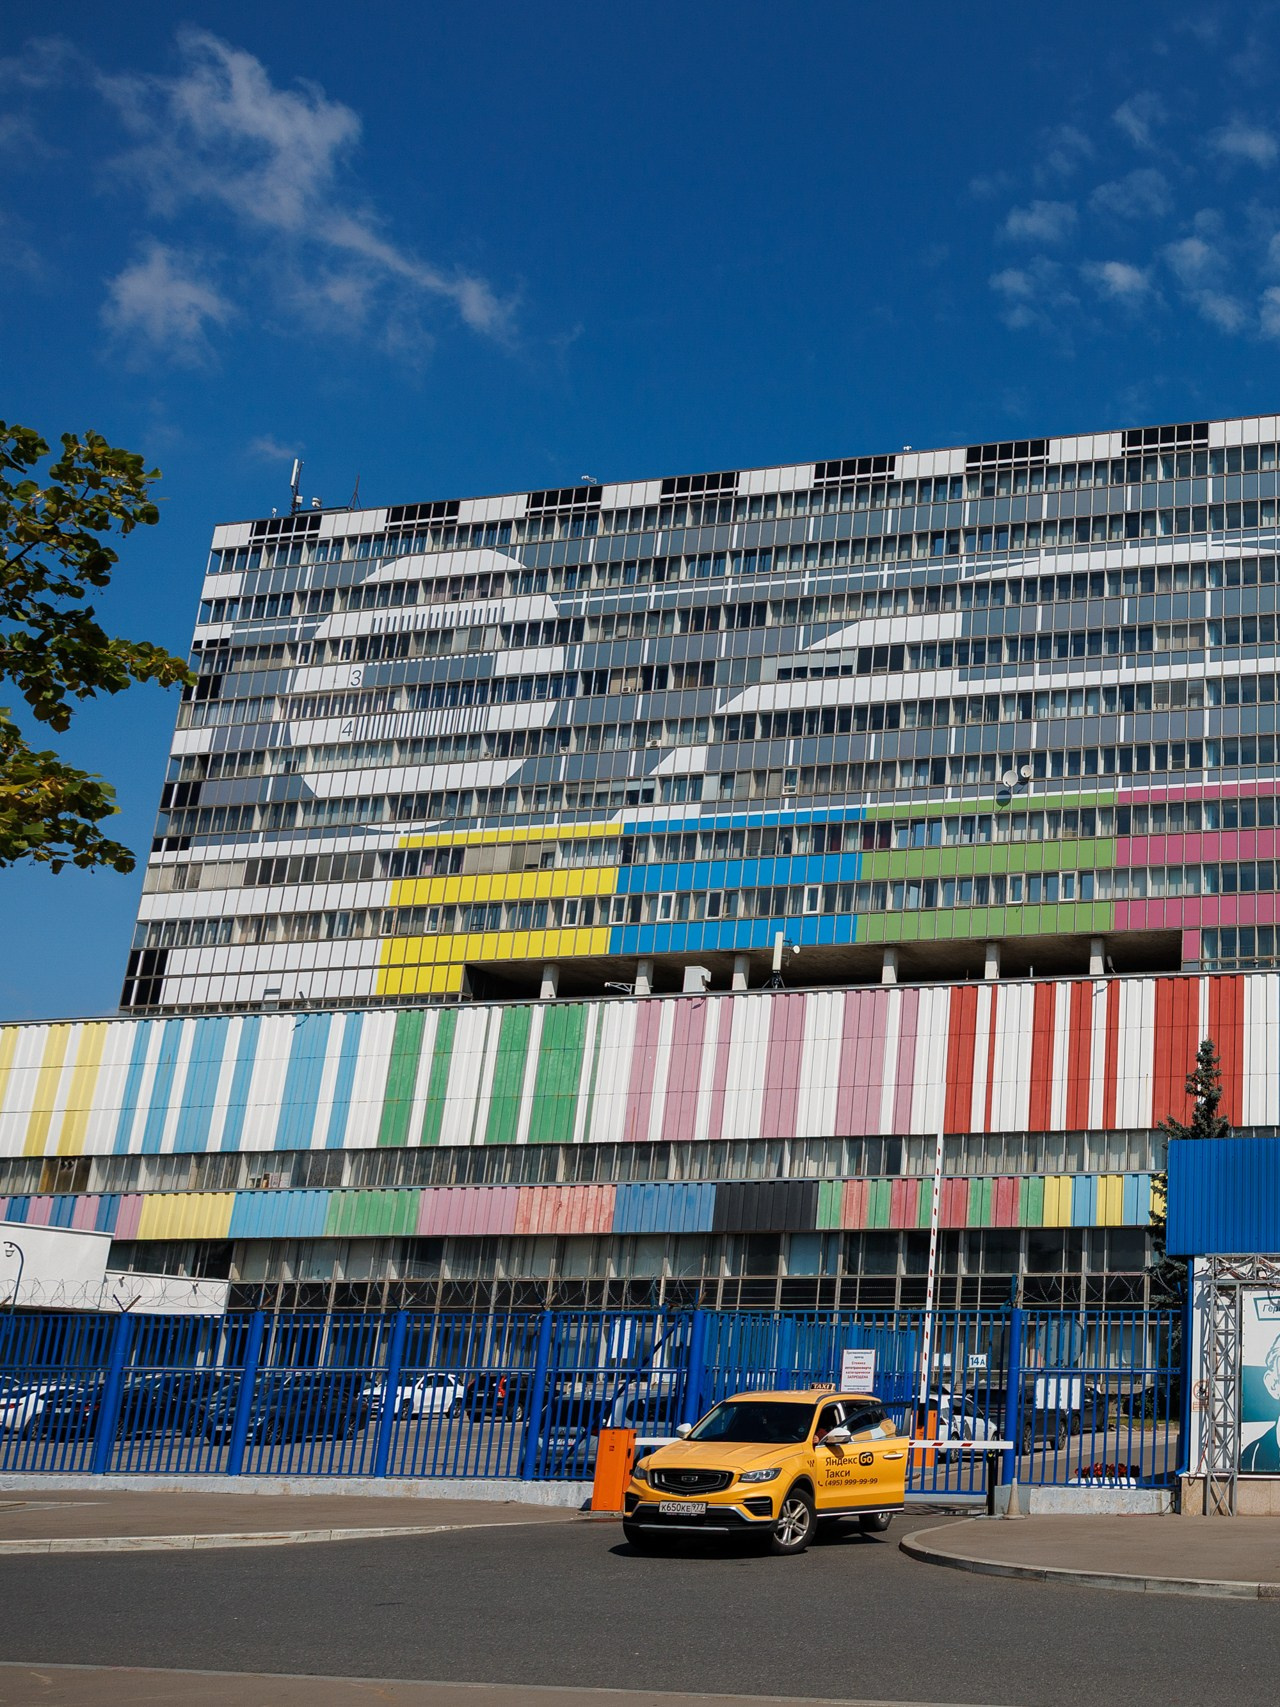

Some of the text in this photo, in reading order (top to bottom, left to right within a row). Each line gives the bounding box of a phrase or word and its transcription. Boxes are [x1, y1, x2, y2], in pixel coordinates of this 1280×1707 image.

[350, 669, 362, 687] 3
[342, 720, 353, 737] 4
[825, 1453, 873, 1466] Яндекс Go
[825, 1469, 851, 1478] Такси
[824, 1477, 878, 1487] (495) 999-99-99
